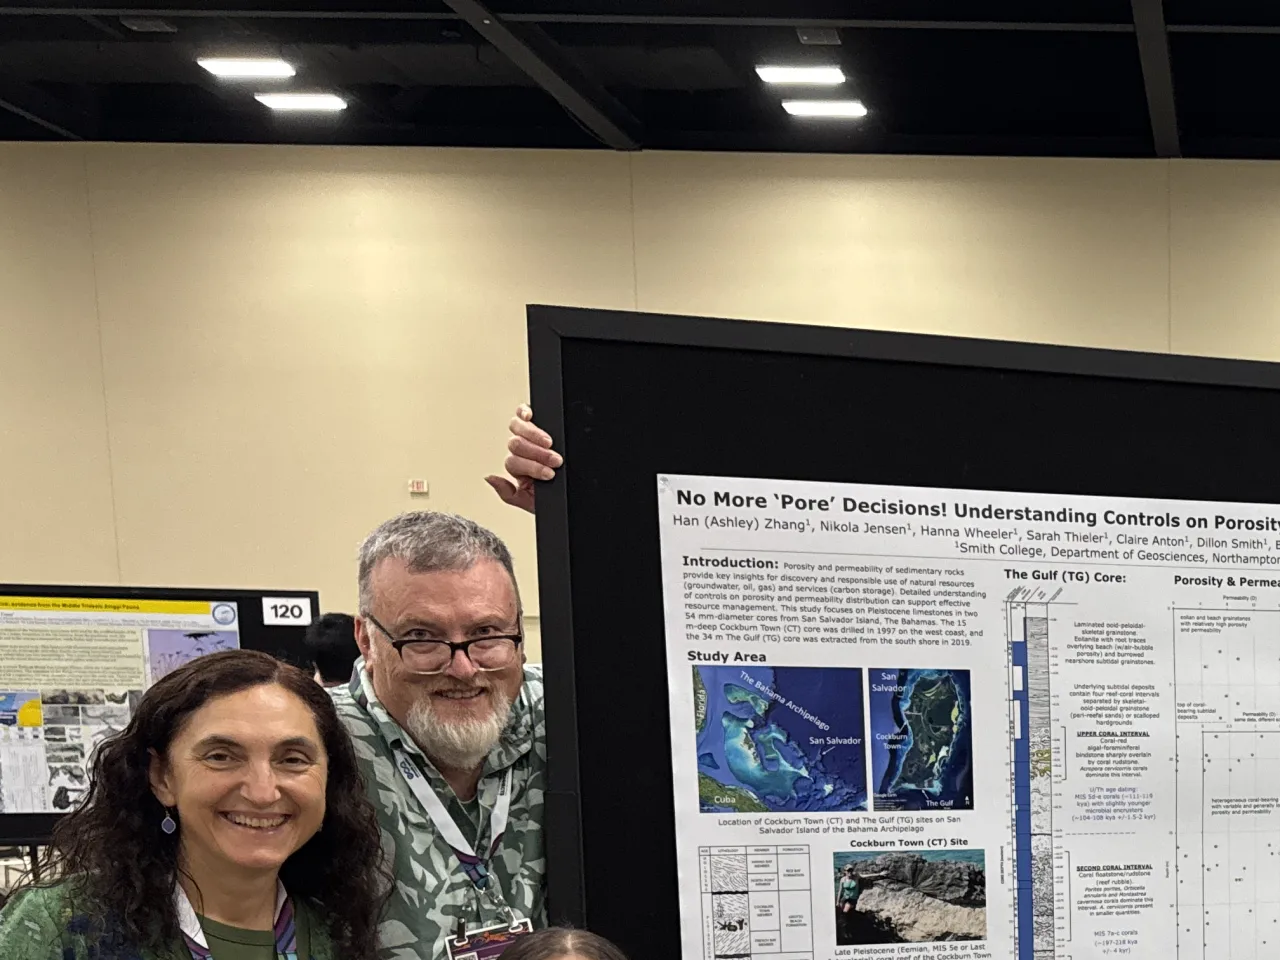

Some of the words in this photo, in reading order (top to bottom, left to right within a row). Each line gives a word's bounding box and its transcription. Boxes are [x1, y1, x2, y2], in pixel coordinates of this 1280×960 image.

[676, 489, 706, 506] No
[713, 491, 767, 508] More
[842, 497, 946, 517] Decisions!
[954, 503, 1096, 527] Understanding
[1103, 510, 1180, 527] Controls
[1185, 516, 1207, 528] on
[673, 514, 699, 526] Han
[704, 515, 759, 531] (Ashley)
[820, 520, 859, 532] Nikola
[920, 525, 959, 537] Hanna
[1026, 529, 1060, 541] Sarah
[1116, 533, 1148, 545] Claire
[1197, 536, 1227, 548] Dillon
[999, 543, 1046, 558] College,
[1050, 546, 1119, 559] Department
[1122, 548, 1134, 559] of
[1137, 549, 1208, 564] Geosciences,
[682, 555, 778, 569] Introduction:
[1003, 568, 1028, 579] The
[1031, 569, 1058, 580] Gulf
[1061, 570, 1089, 584] (TG)
[1094, 572, 1126, 583] Core:
[1174, 575, 1223, 588] Porosity
[1226, 576, 1236, 586] &
[270, 604, 303, 618] 120
[687, 650, 729, 664] Study
[733, 651, 766, 662] Area
[881, 672, 896, 680] San
[872, 684, 906, 692] Salvador
[697, 689, 705, 719] Florida
[739, 670, 754, 685] The
[755, 681, 786, 704] Bahama
[786, 700, 830, 732] Archipelago
[809, 736, 824, 745] San
[826, 736, 861, 745] Salvador
[714, 795, 736, 804] Cuba
[849, 839, 895, 847] Cockburn
[926, 838, 947, 847] (CT)
